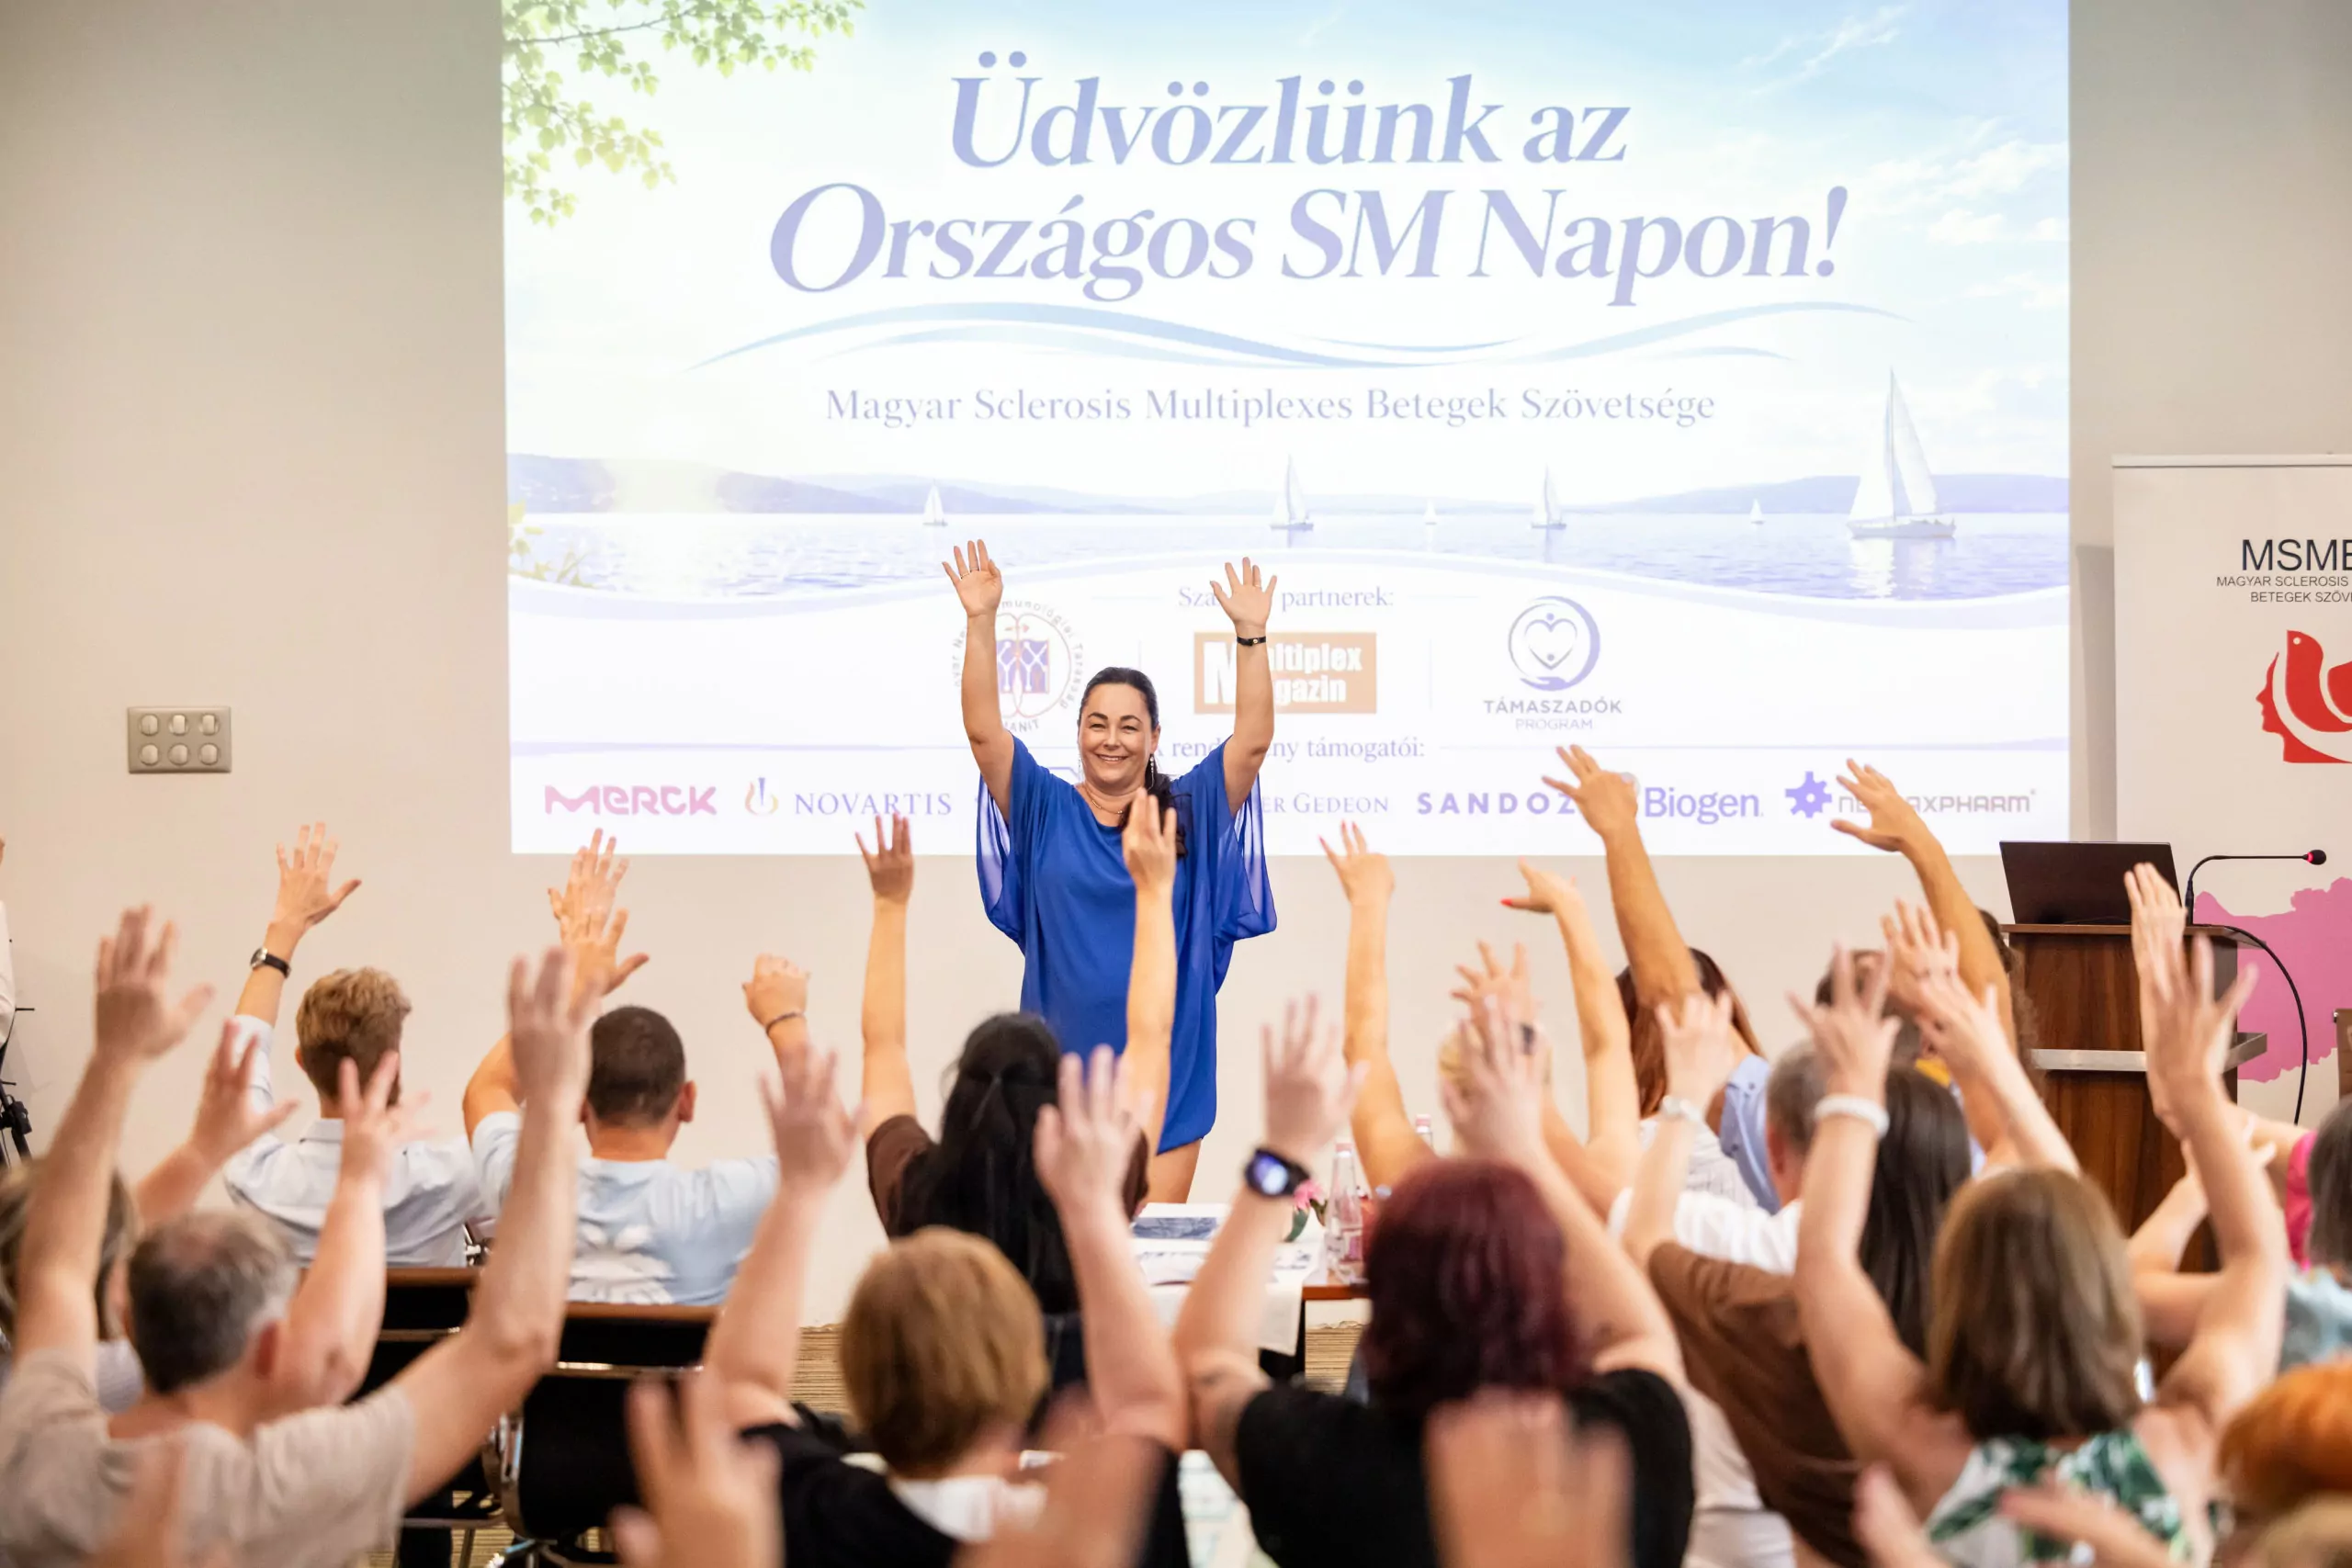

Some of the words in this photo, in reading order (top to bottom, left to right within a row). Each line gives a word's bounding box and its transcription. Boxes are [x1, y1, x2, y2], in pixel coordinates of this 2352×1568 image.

[951, 51, 1503, 167] Üdvözlünk
[1522, 106, 1631, 164] az
[770, 183, 1256, 301] Országos
[1281, 188, 1454, 280] SM
[1467, 186, 1849, 307] Napon!
[827, 389, 962, 429] Magyar
[975, 389, 1132, 421] Sclerosis
[1147, 388, 1353, 428] Multiplexes
[1367, 388, 1507, 428] Betegek
[1521, 387, 1715, 428] Szövetsége
[2216, 575, 2271, 587] MAGYAR
[2275, 575, 2349, 587] SCLEROSIS
[1282, 585, 1395, 607] partnerek:
[2250, 591, 2312, 603] BETEGEK
[2315, 589, 2352, 603] SZÖV
[1483, 696, 1623, 715] TÁMASZADÓK
[1515, 718, 1593, 730] PROGRAM
[1306, 736, 1426, 762] támogatói:
[795, 793, 952, 815] NOVARTIS
